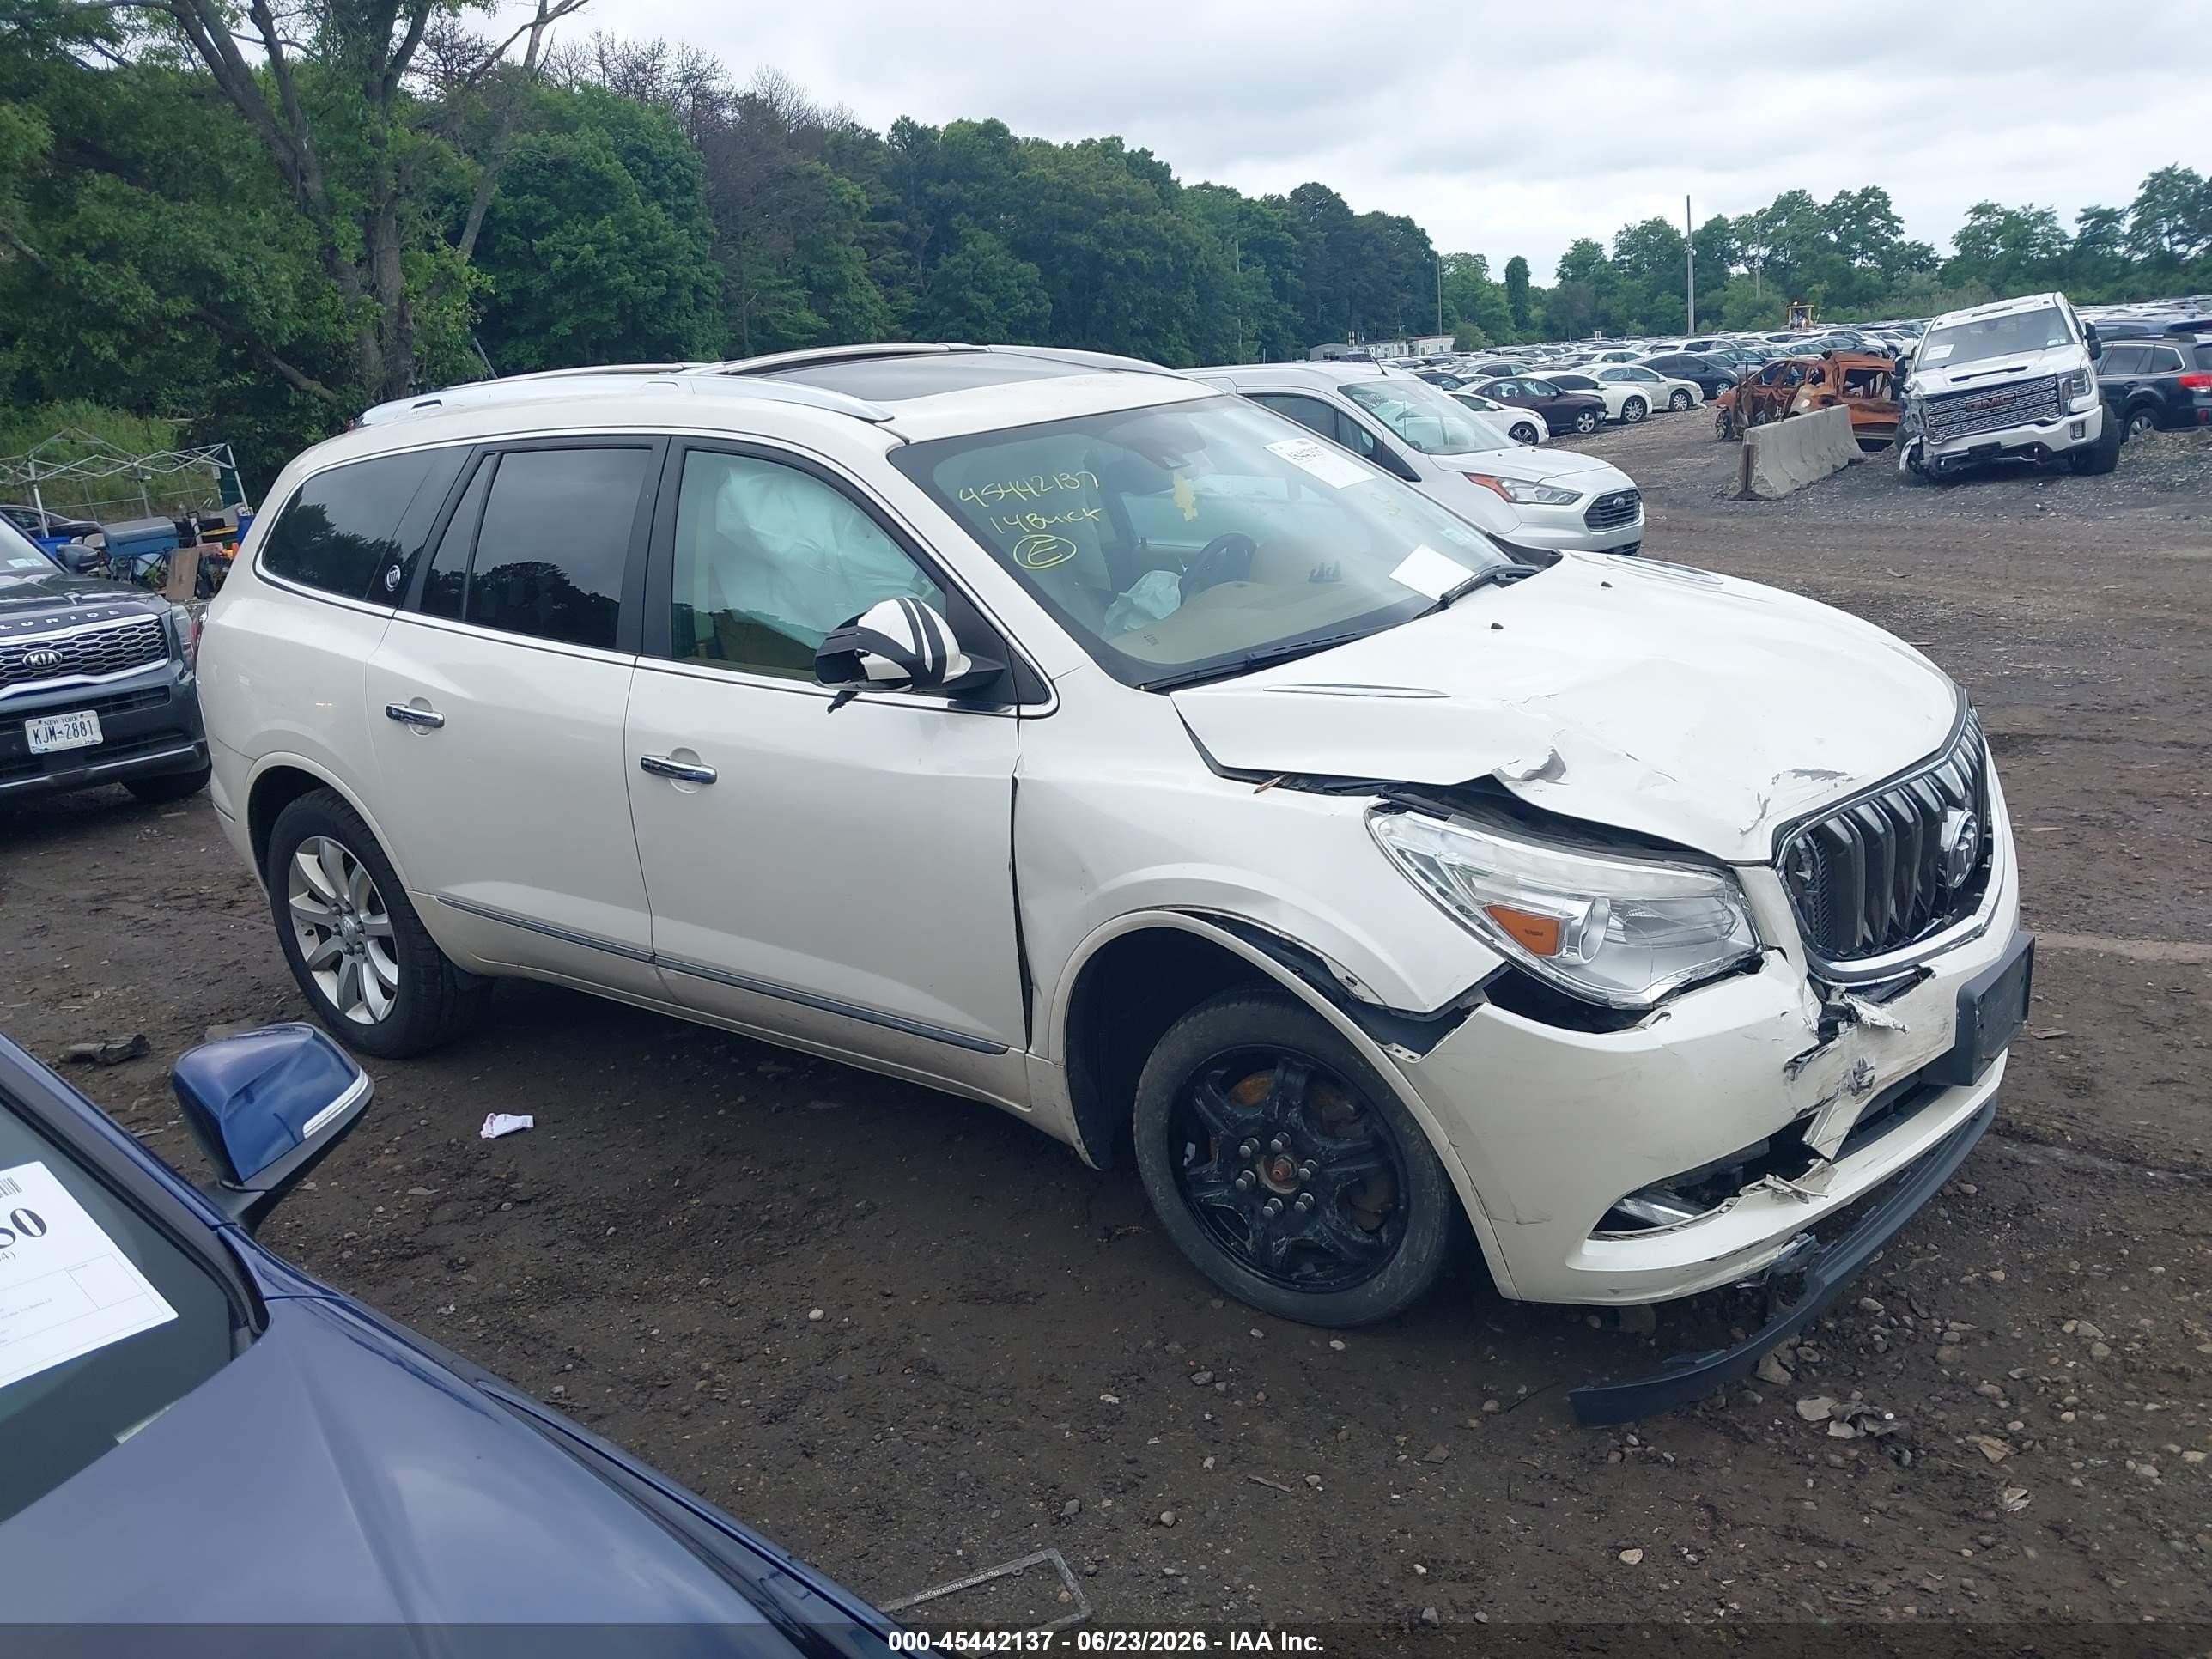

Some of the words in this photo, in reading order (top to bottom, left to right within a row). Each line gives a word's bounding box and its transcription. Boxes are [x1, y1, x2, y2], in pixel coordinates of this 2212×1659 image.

[1966, 392, 2017, 412] GMC
[959, 471, 1099, 507] 45442137
[28, 652, 59, 666] KIA
[966, 1570, 1000, 1584] Porsche
[913, 1582, 963, 1601] Huntington
